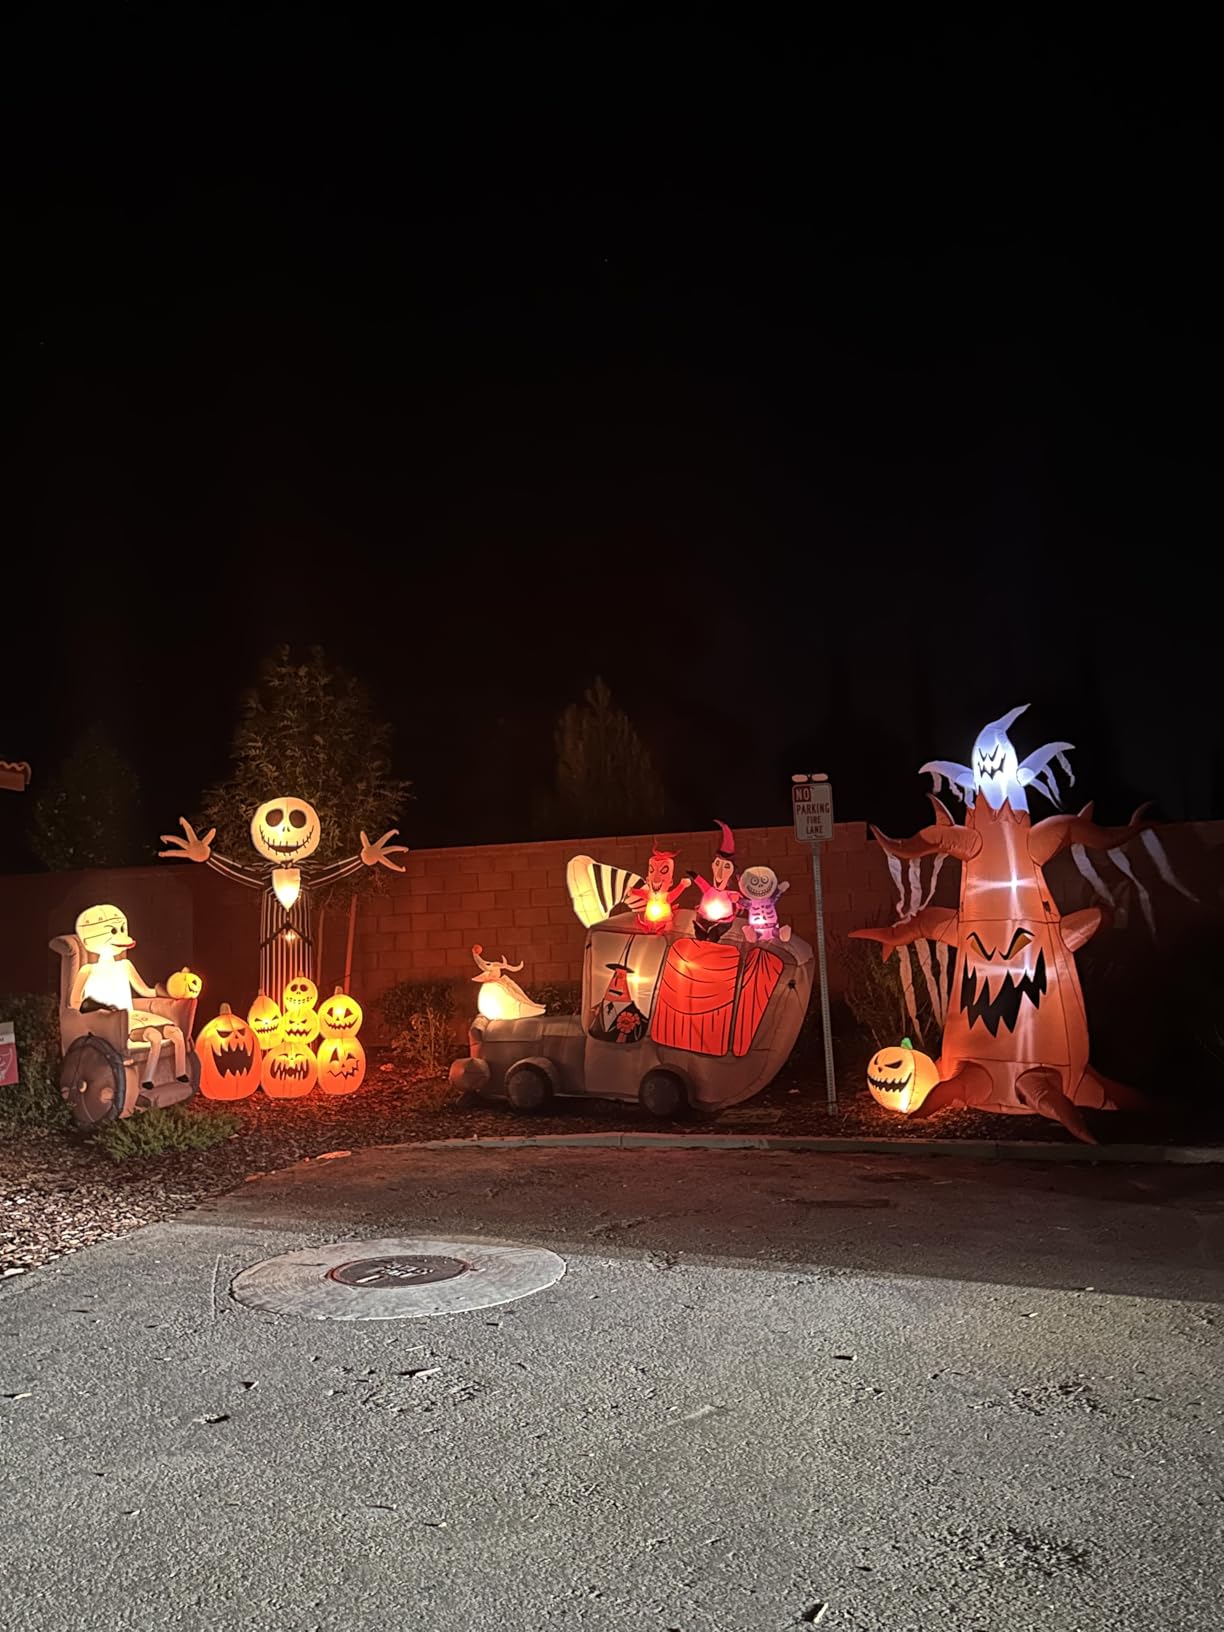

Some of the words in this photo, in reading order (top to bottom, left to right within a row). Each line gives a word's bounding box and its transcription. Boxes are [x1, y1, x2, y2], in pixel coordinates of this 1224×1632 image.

[795, 788, 810, 801] NO
[796, 803, 829, 814] PARKING
[806, 816, 821, 824] FIRE
[806, 825, 823, 834] LANE
